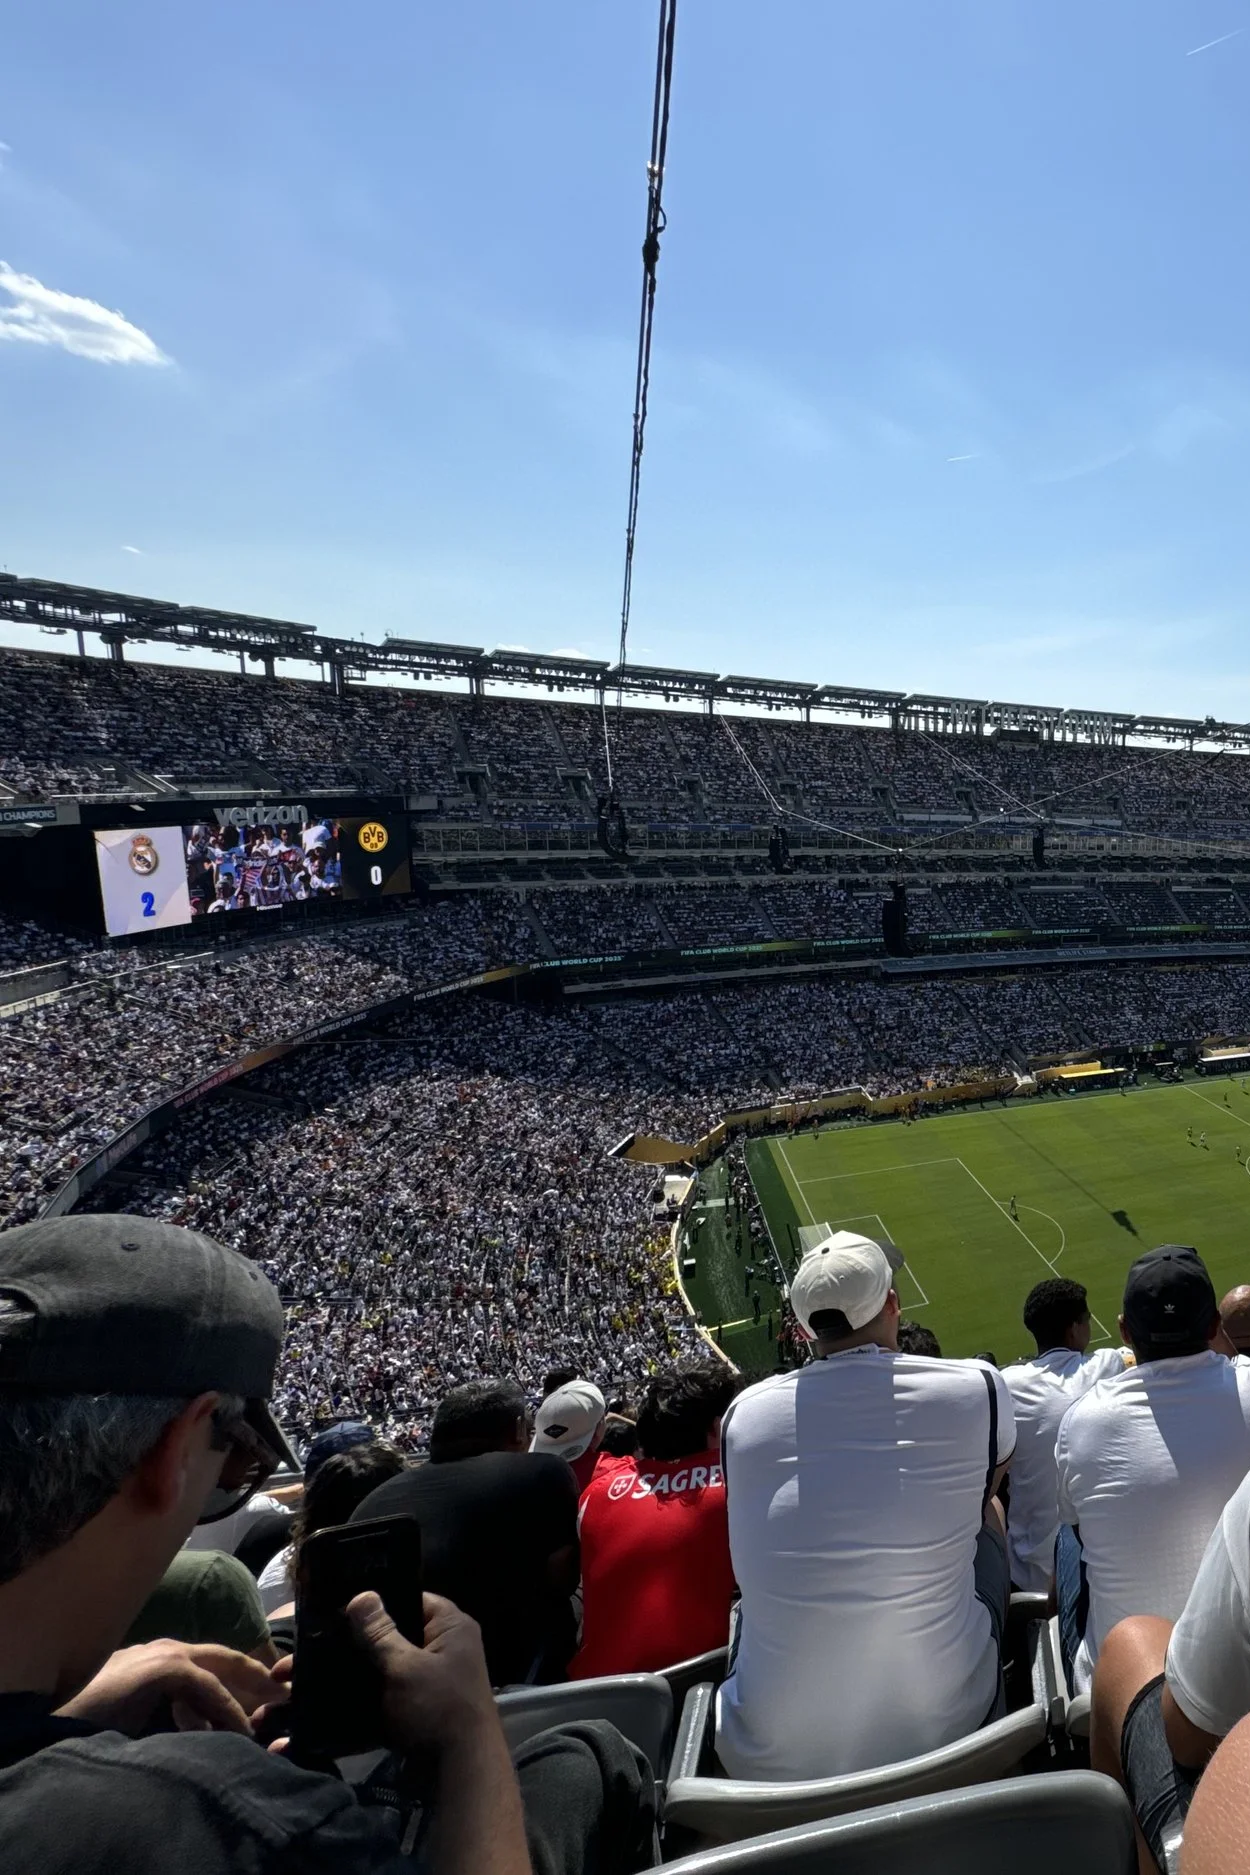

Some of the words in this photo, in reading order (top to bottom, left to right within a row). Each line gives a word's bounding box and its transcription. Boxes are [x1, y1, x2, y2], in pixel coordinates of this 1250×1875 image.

[1037, 708, 1113, 734] STADIUM
[3, 809, 56, 821] CHAMPIONS
[213, 801, 308, 828] verizon
[363, 826, 384, 843] BVB
[370, 865, 383, 886] 0
[141, 892, 156, 917] 2
[631, 1464, 724, 1500] SAGRE
